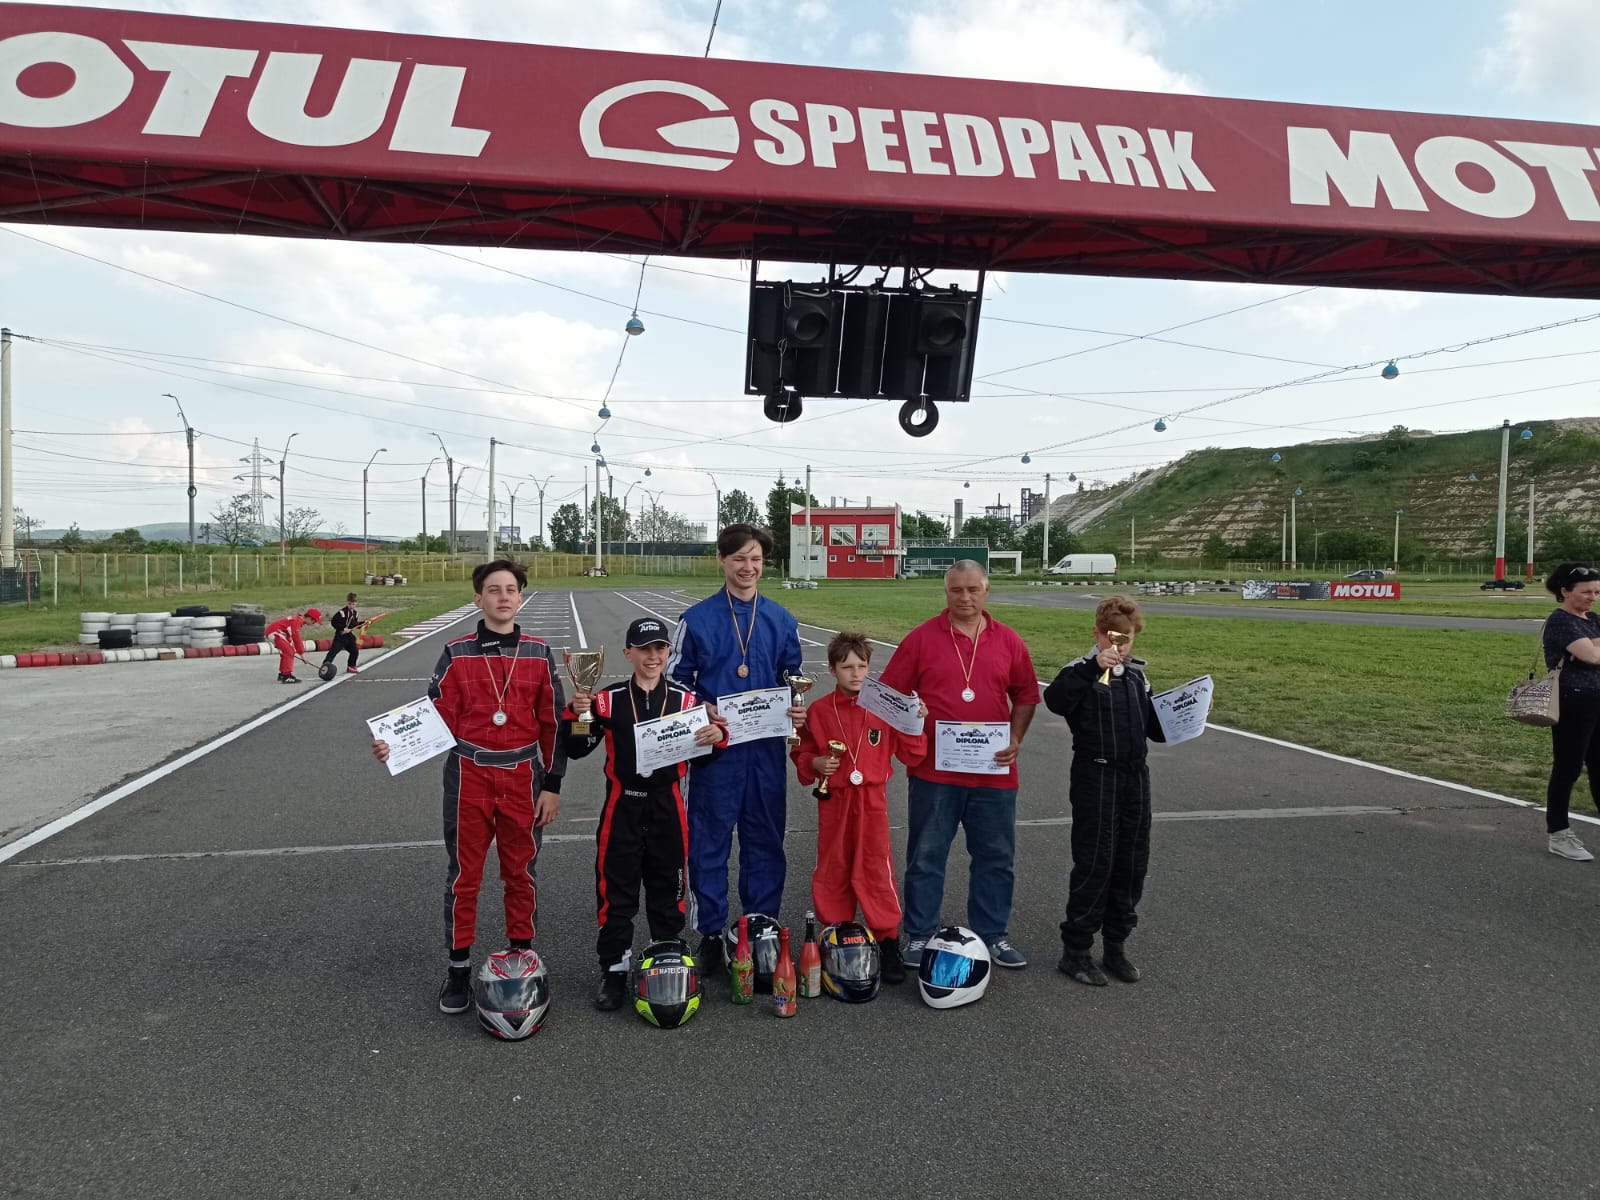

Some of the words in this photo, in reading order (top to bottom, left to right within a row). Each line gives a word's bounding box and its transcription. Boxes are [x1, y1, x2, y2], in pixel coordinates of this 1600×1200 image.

[749, 98, 1216, 193] SPEEDPARK
[1286, 126, 1600, 219] MOT
[1333, 584, 1395, 597] MOTUL
